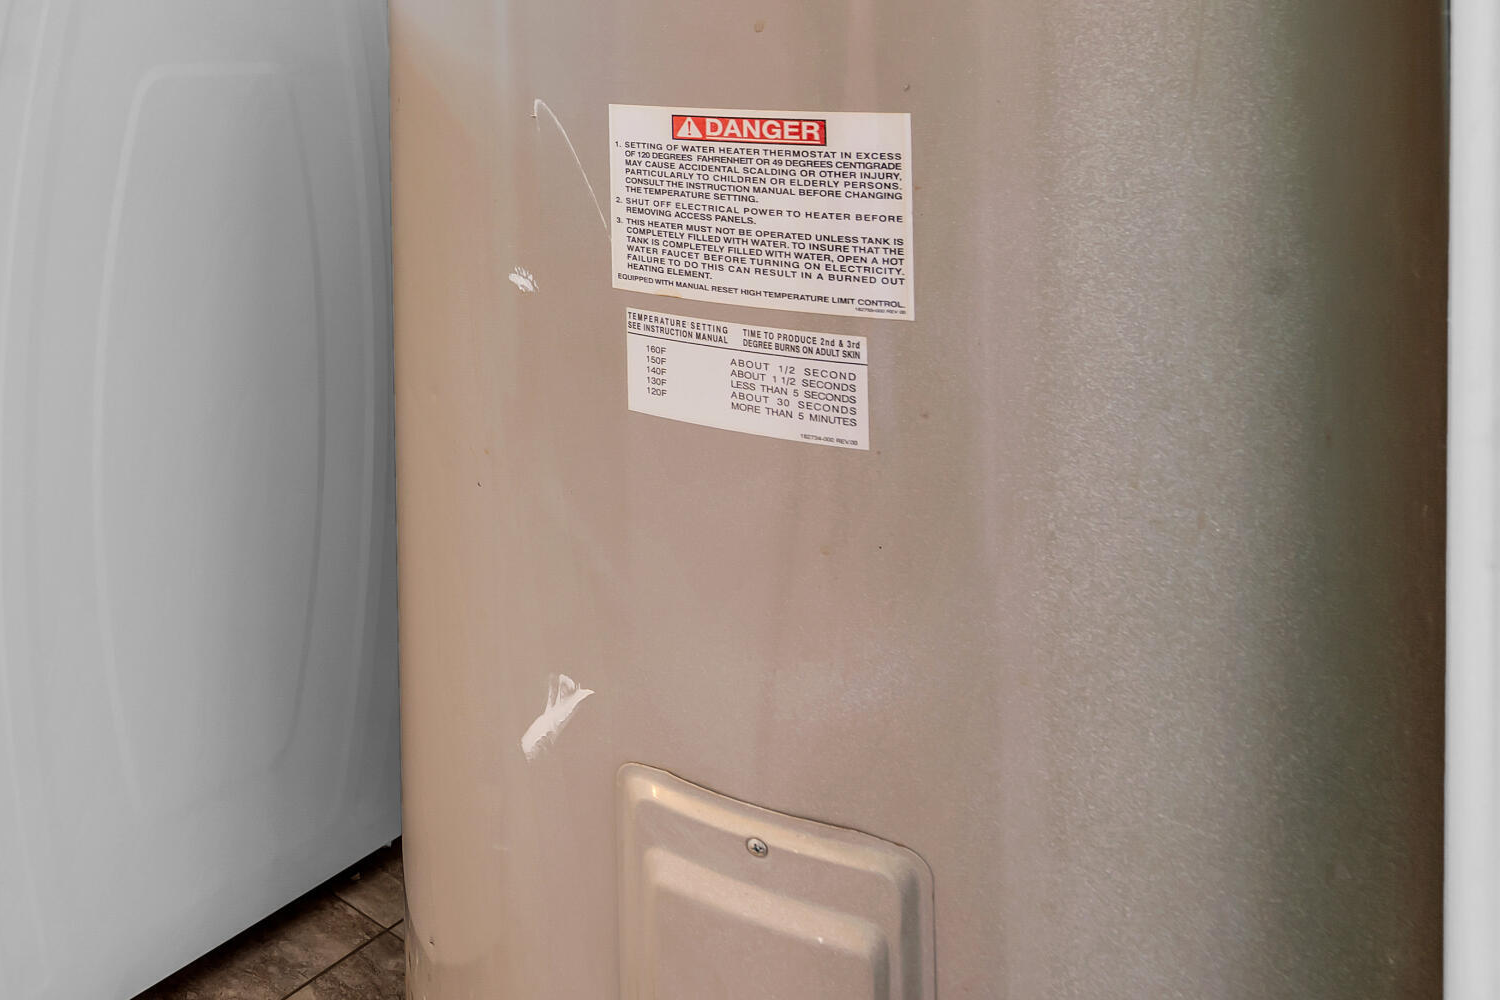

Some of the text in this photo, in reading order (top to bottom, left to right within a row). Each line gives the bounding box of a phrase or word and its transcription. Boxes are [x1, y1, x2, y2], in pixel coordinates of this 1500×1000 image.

[706, 118, 820, 140] DANGER
[625, 142, 662, 150] SETTING
[682, 145, 715, 153] WATER
[719, 147, 760, 156] HEATER
[763, 150, 836, 159] THERMOSTAT
[653, 152, 692, 161] DEGREES
[697, 155, 752, 164] FAHRENHEIT
[836, 162, 901, 170] CENTIGRADE
[628, 312, 728, 334] TEMPERATURE SETTING
[628, 321, 728, 344] SEE INSTRUCTION MANUAL
[743, 329, 761, 338] TIME
[778, 334, 816, 344] PRODUCE
[821, 338, 835, 346] 2nd
[847, 341, 860, 349] 3rd
[743, 339, 772, 350] DEGREE
[775, 344, 799, 353] BURNS
[816, 348, 840, 357] ADULT
[842, 351, 860, 359] SKIN
[646, 346, 666, 354] 160F
[646, 356, 666, 364] 150F
[647, 366, 666, 375] 140F
[730, 358, 856, 381] ABOUT 1/2 SECOND
[647, 377, 666, 385] 130F
[731, 369, 766, 381] ABOUT
[782, 377, 796, 385] 1/2
[802, 379, 856, 392] SECONDS
[647, 387, 667, 396] 120F
[731, 380, 755, 390] LESS
[761, 385, 788, 396] THAN
[804, 391, 856, 404] SECONDS
[731, 392, 769, 403] ABOUT
[798, 401, 856, 415] SECONDS
[732, 402, 760, 414] MORE
[766, 408, 792, 418] THAN
[810, 414, 856, 426] MINUTES
